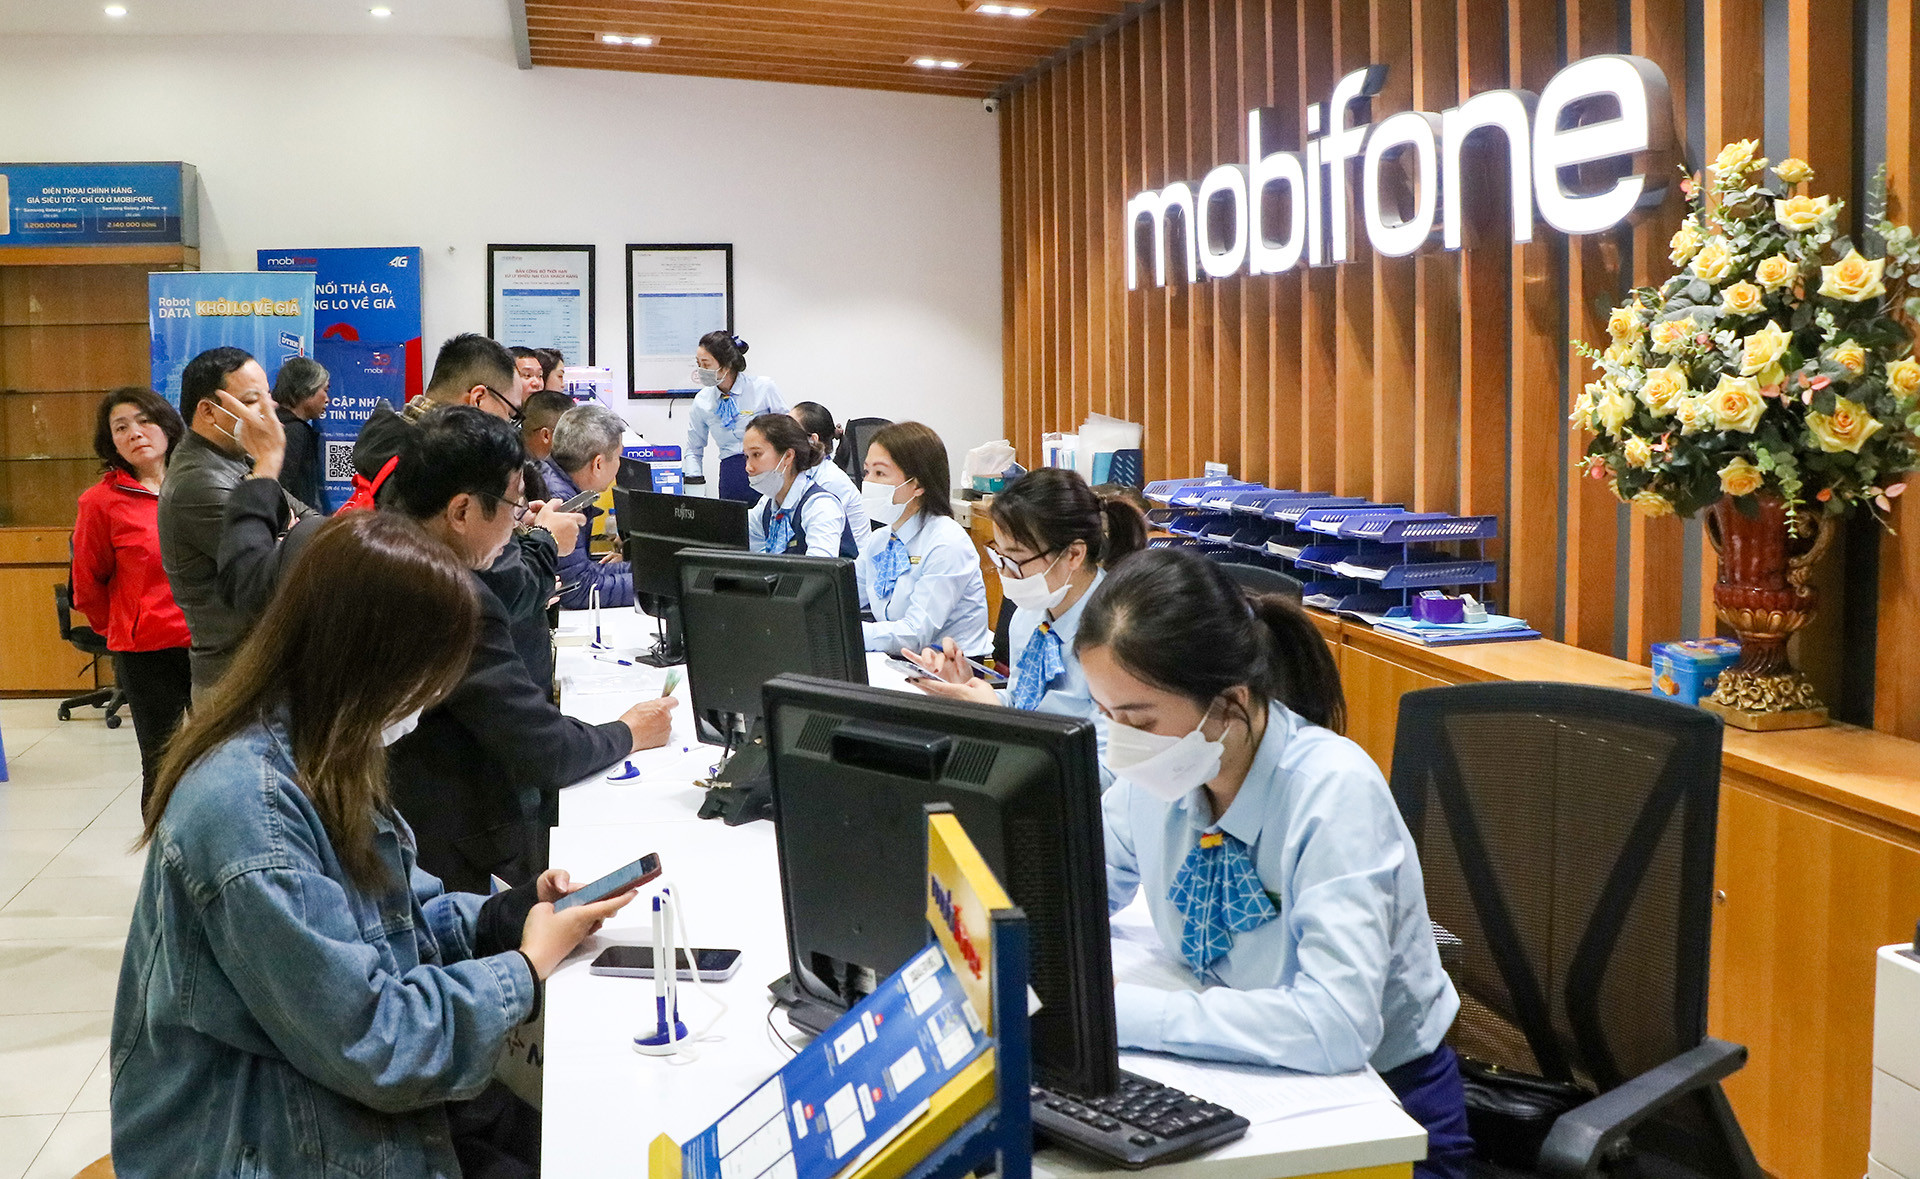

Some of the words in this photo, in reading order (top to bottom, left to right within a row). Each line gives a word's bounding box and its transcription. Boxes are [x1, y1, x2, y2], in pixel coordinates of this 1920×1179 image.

[1127, 53, 1650, 290] mobifone
[268, 256, 317, 265] mobifone
[388, 256, 408, 268] 4G
[370, 284, 392, 294] GA,
[158, 298, 190, 307] Robot
[233, 302, 251, 314] LO
[253, 298, 272, 314] VỀ
[275, 298, 299, 314] GIÁ
[332, 300, 348, 310] LO
[351, 296, 369, 309] VỀ
[374, 296, 396, 309] GIÁ
[158, 308, 191, 318] DATA
[332, 395, 355, 409] CẬP
[329, 410, 346, 420] TIN
[627, 448, 676, 458] mobifone
[674, 504, 695, 520] FUJITSU
